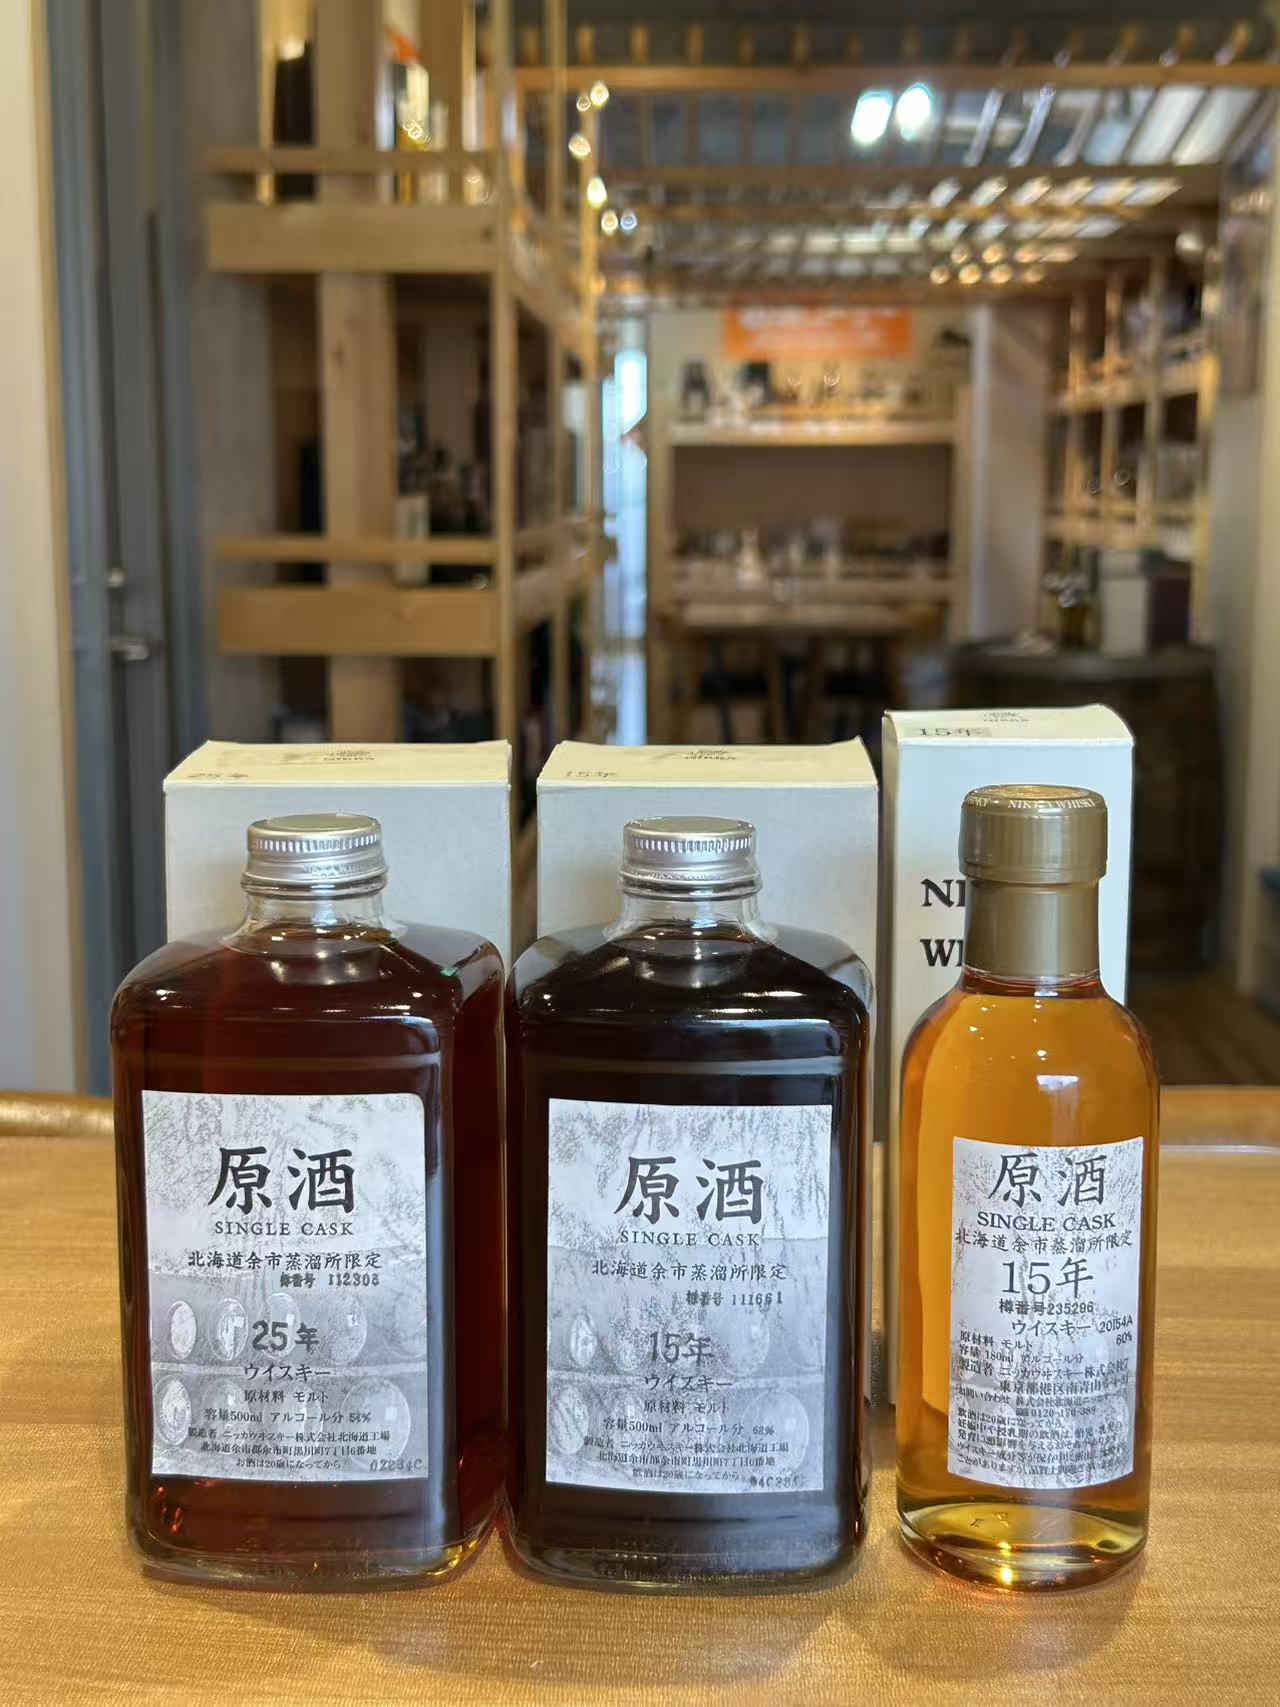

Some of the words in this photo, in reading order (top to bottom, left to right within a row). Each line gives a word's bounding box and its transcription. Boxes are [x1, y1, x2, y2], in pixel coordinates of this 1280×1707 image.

[208, 1146, 355, 1214] 原酒
[988, 1151, 1108, 1208] 原酒
[613, 1155, 764, 1225] 原酒
[214, 1221, 291, 1237] SINGLE
[301, 1221, 354, 1237] CASK
[977, 1211, 1056, 1232] SINGLE
[1062, 1211, 1117, 1232] CASK
[619, 1230, 698, 1246] SINGLE
[708, 1231, 760, 1247] CASK
[955, 1227, 1133, 1256] 北海道余市蒸溜所限定
[187, 1251, 383, 1271] 北海道余市蒸溜所限定
[591, 1260, 788, 1282] 北海道余市蒸溜所限定
[1002, 1256, 1094, 1299] 15年
[252, 1319, 320, 1354] 25年
[1012, 1319, 1092, 1337] ウイスキー
[649, 1331, 716, 1365] 15年
[960, 1330, 995, 1347] 原材料
[1001, 1339, 1033, 1352] モルト
[243, 1363, 332, 1383] ウイスキー
[644, 1373, 733, 1392] ウイスキー
[244, 1389, 286, 1404] 原材料
[292, 1390, 329, 1404] モルト
[643, 1399, 687, 1414] 原材料
[693, 1400, 730, 1414] モルト
[270, 1410, 344, 1424] アルコール分
[669, 1422, 745, 1436] アルコール分
